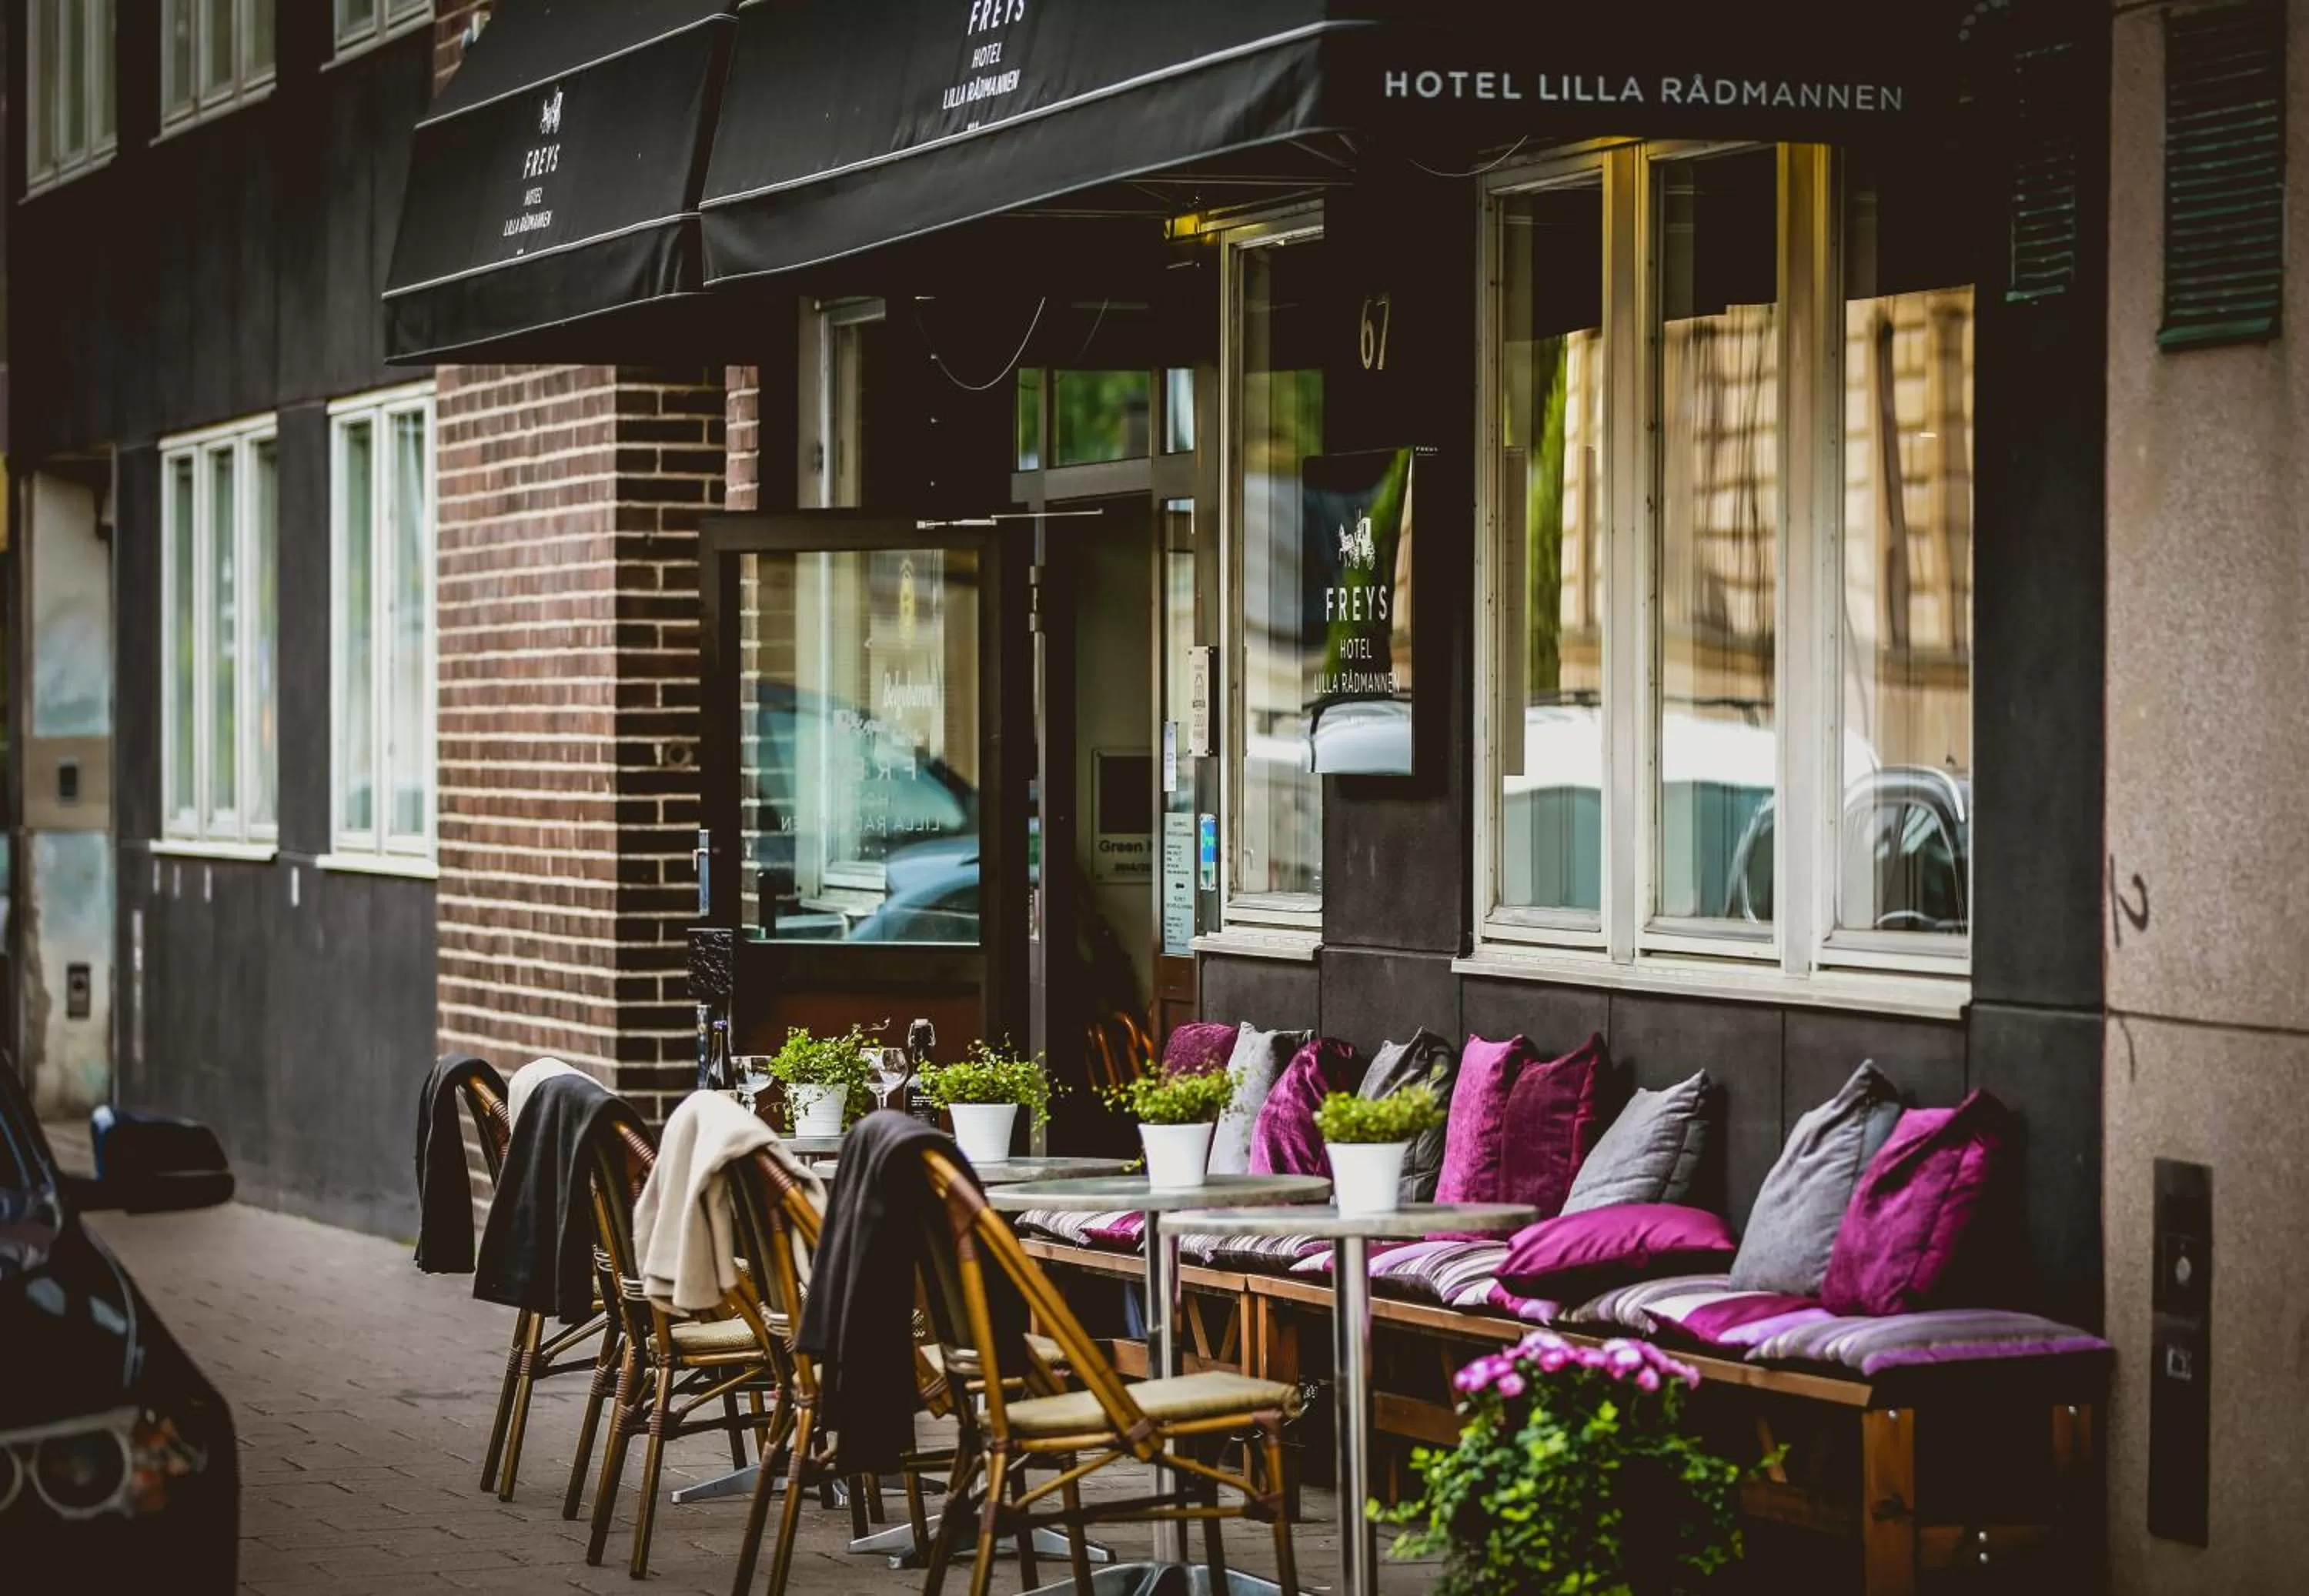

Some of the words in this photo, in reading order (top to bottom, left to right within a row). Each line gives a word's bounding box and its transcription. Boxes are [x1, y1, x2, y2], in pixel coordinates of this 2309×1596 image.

[967, 0, 1024, 35] FREYS
[971, 42, 1002, 68] HOTEL
[943, 84, 966, 109] LILLA
[1385, 70, 1522, 98] HOTEL
[1539, 74, 1644, 102] LILLA
[1660, 73, 1903, 110] RÅDMANNEN
[523, 143, 561, 179] FREYS
[1360, 298, 1389, 370] 67
[1325, 585, 1388, 621] FREYS
[1340, 638, 1372, 659] HOTEL
[1314, 673, 1338, 693] LILLA
[1342, 668, 1401, 693] RÅDMANNEN
[1098, 839, 1144, 853] Green
